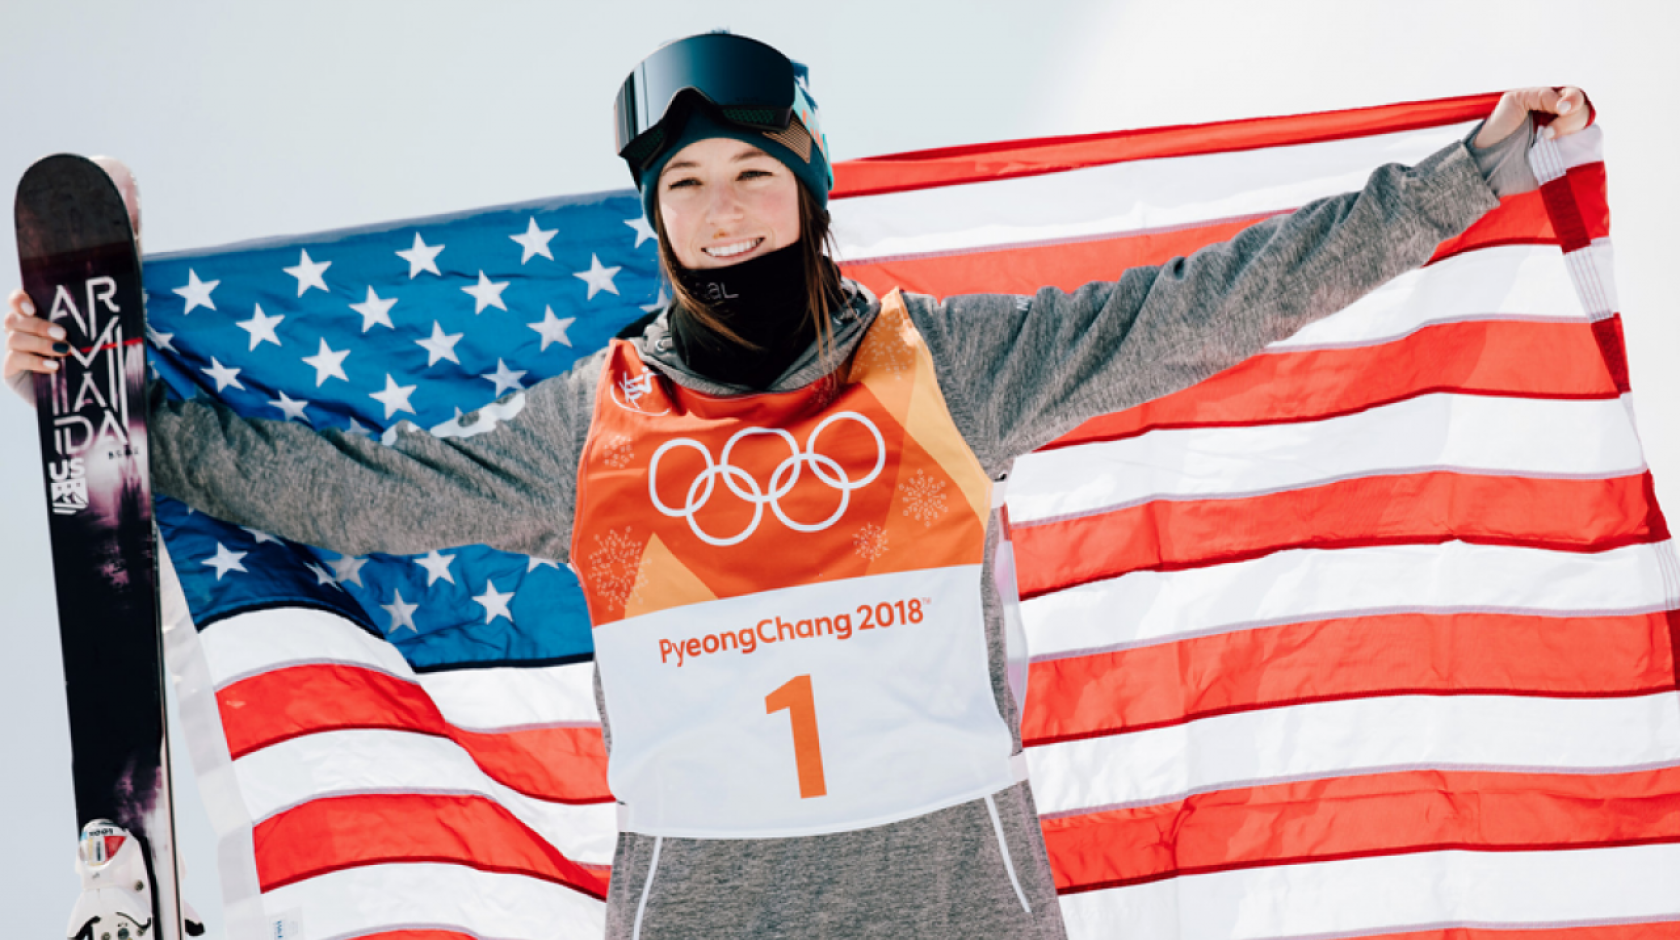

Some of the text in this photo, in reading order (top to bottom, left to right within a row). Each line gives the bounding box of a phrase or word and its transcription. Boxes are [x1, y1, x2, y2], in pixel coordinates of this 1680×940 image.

[49, 457, 85, 482] US
[658, 611, 853, 667] PyeongChang
[856, 597, 924, 632] 2018
[764, 673, 828, 799] 1
